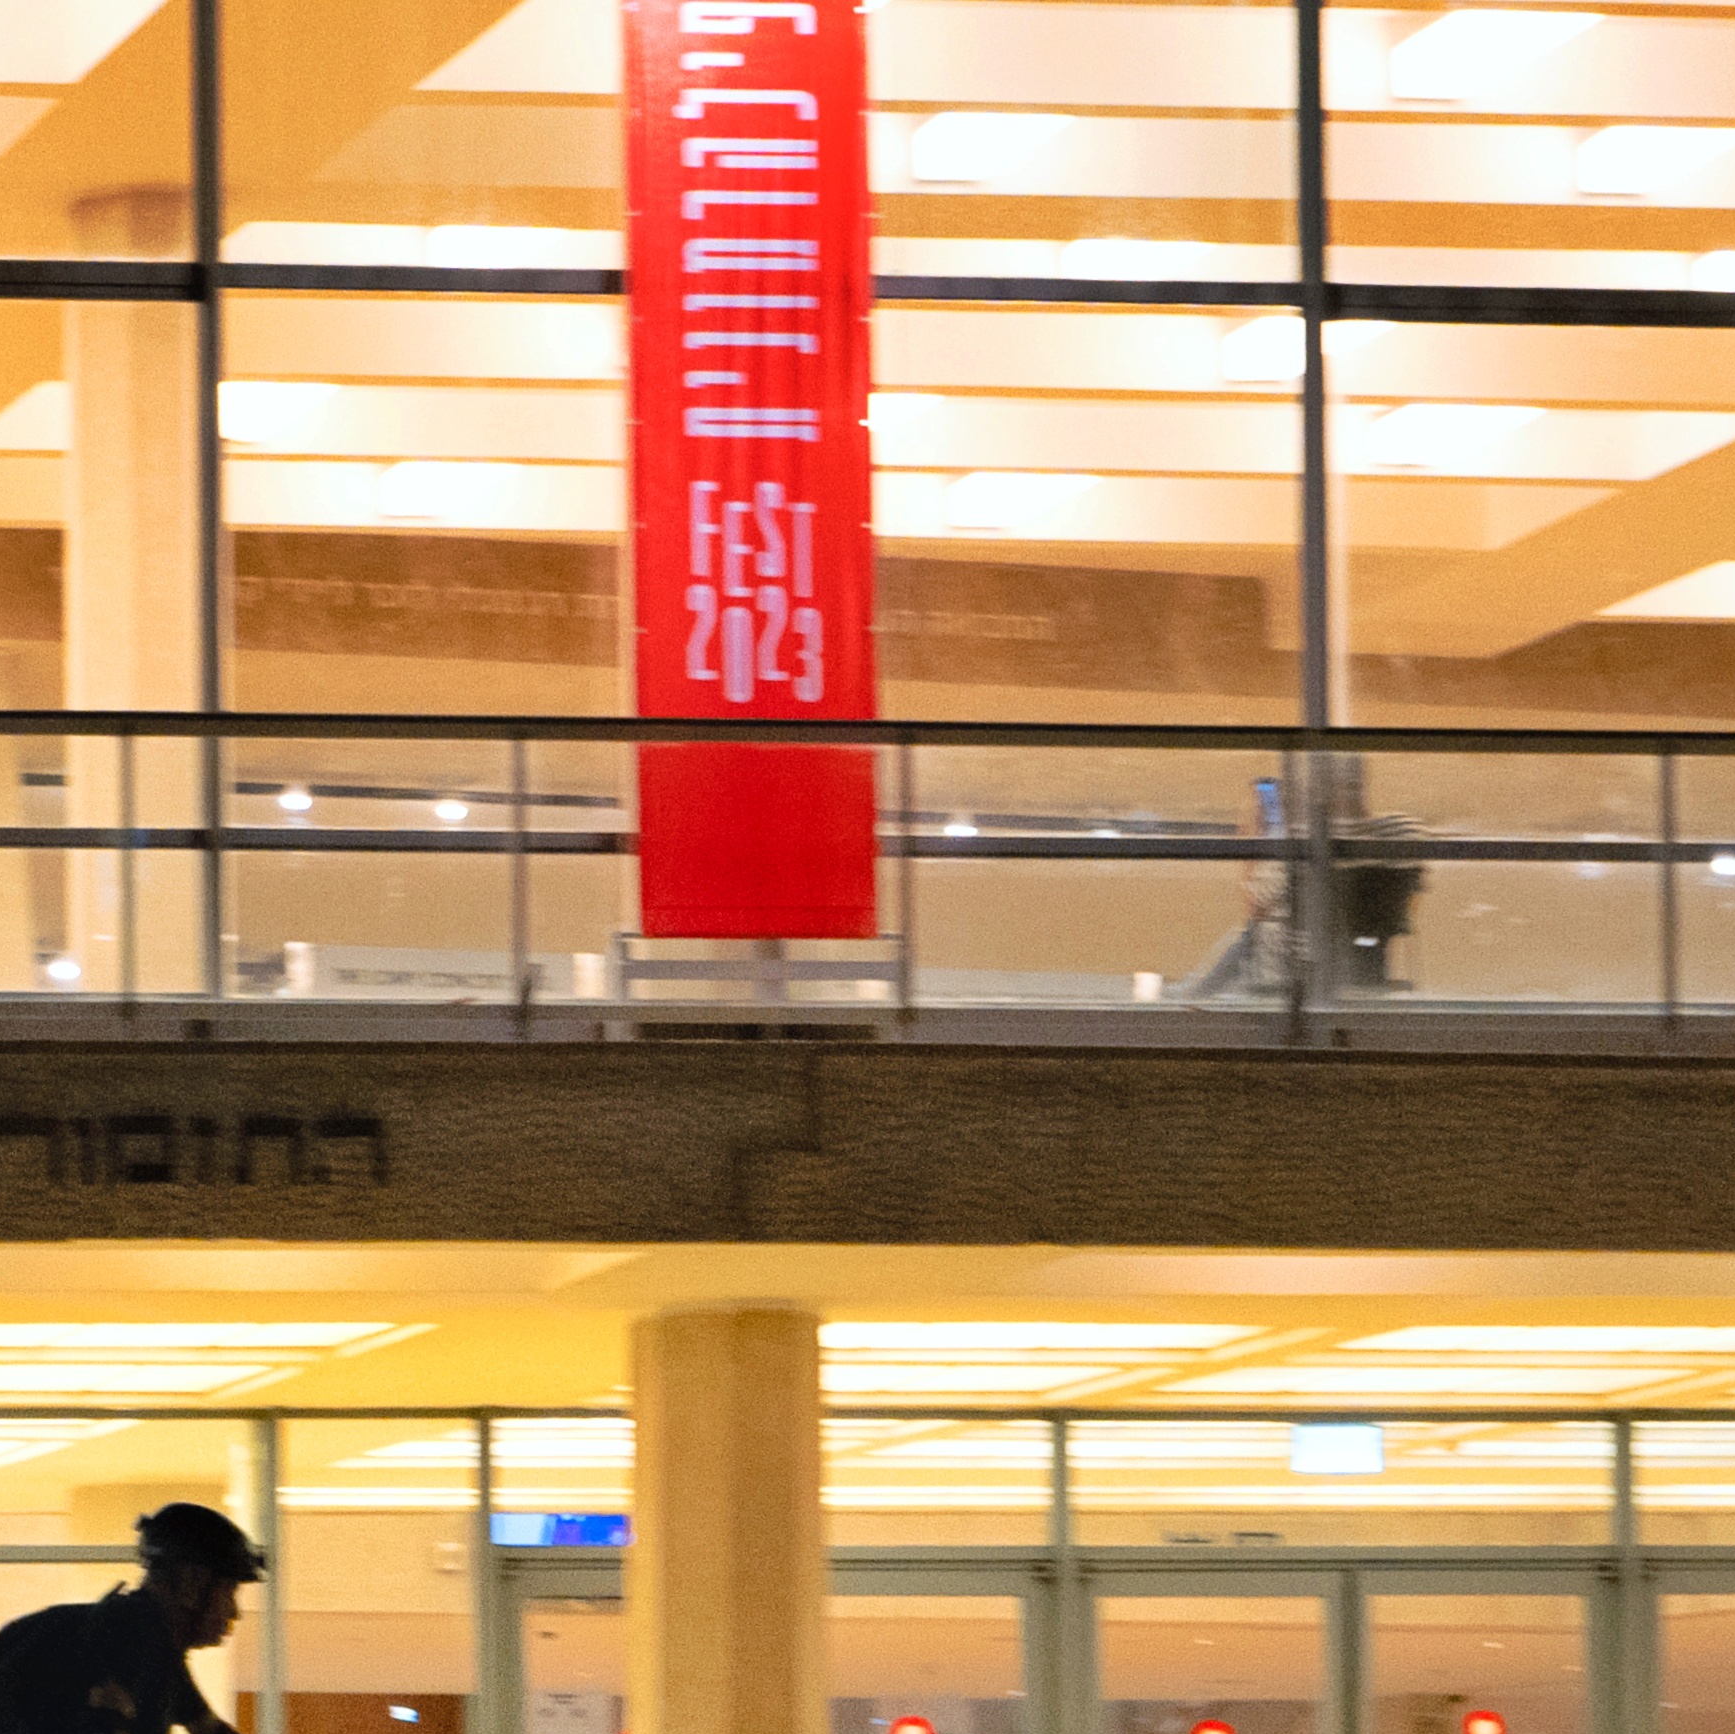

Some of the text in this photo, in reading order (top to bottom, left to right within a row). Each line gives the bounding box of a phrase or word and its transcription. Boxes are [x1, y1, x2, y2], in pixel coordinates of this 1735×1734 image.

[672, 1, 821, 443] פילהרמונית
[687, 480, 818, 599] FEST
[684, 584, 825, 704] 2023
